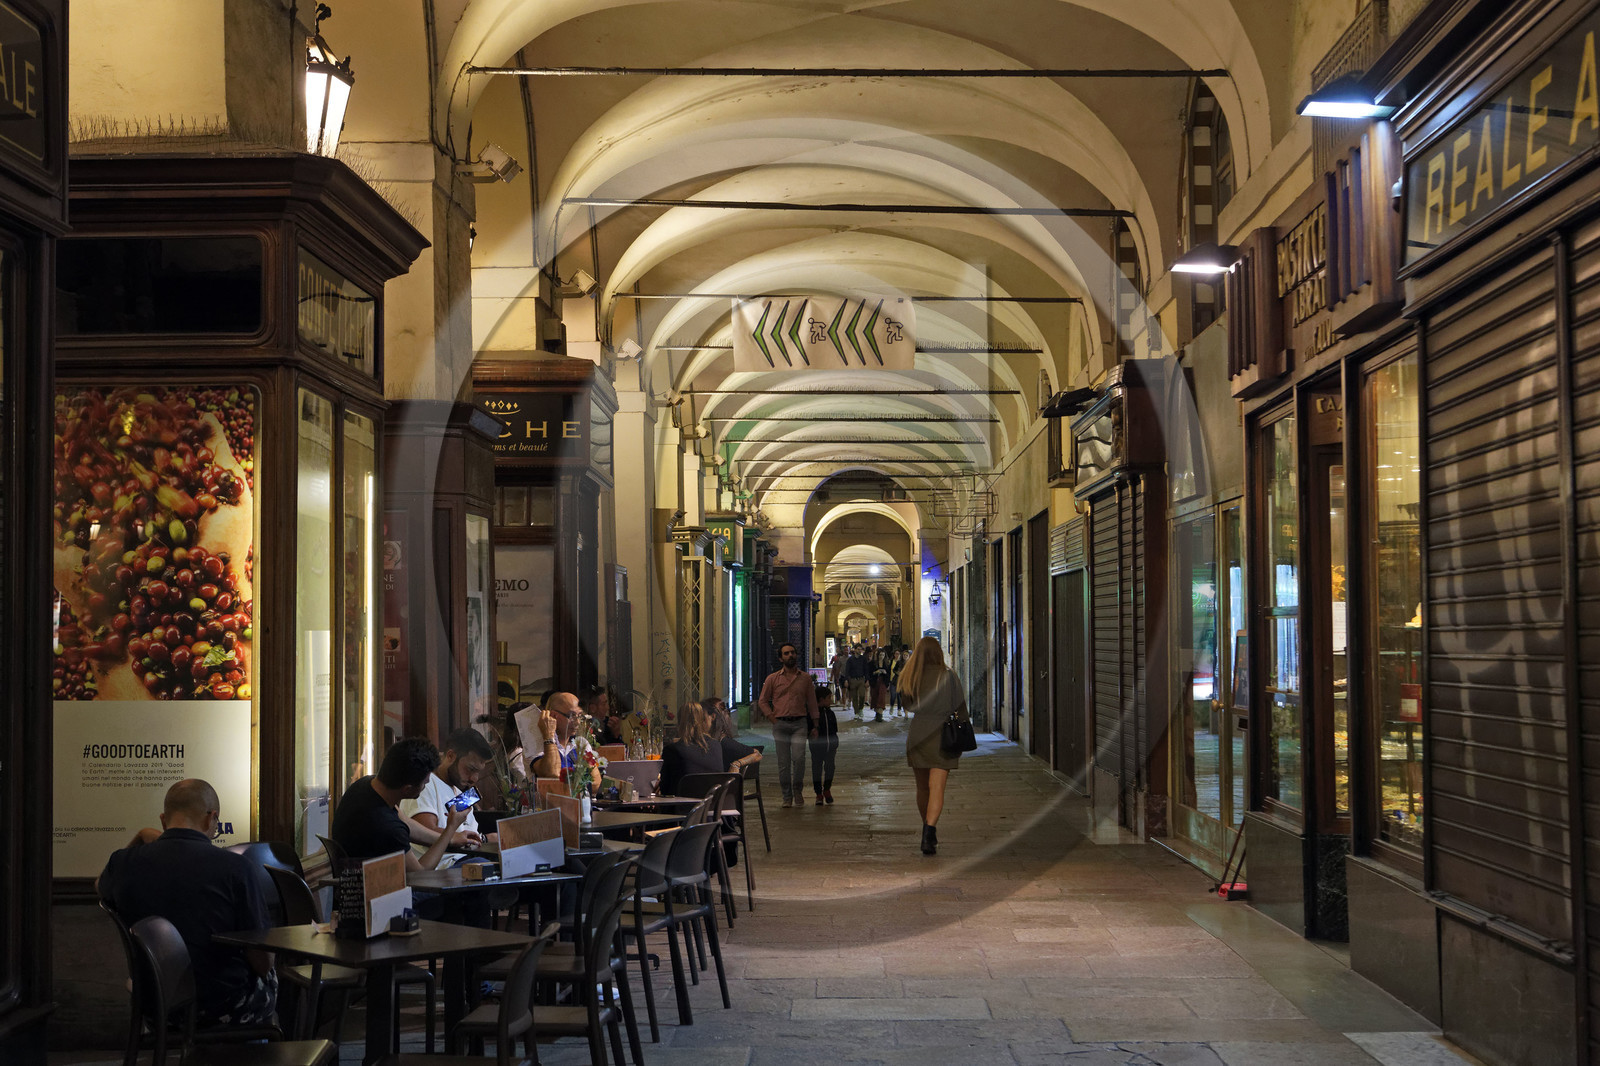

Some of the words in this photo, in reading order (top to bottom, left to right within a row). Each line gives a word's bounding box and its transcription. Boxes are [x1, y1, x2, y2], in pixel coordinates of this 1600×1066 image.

[1423, 64, 1553, 243] REALE
[508, 443, 517, 452] et
[519, 441, 548, 452] beauté
[83, 744, 185, 759] #GOODTOEARTH
